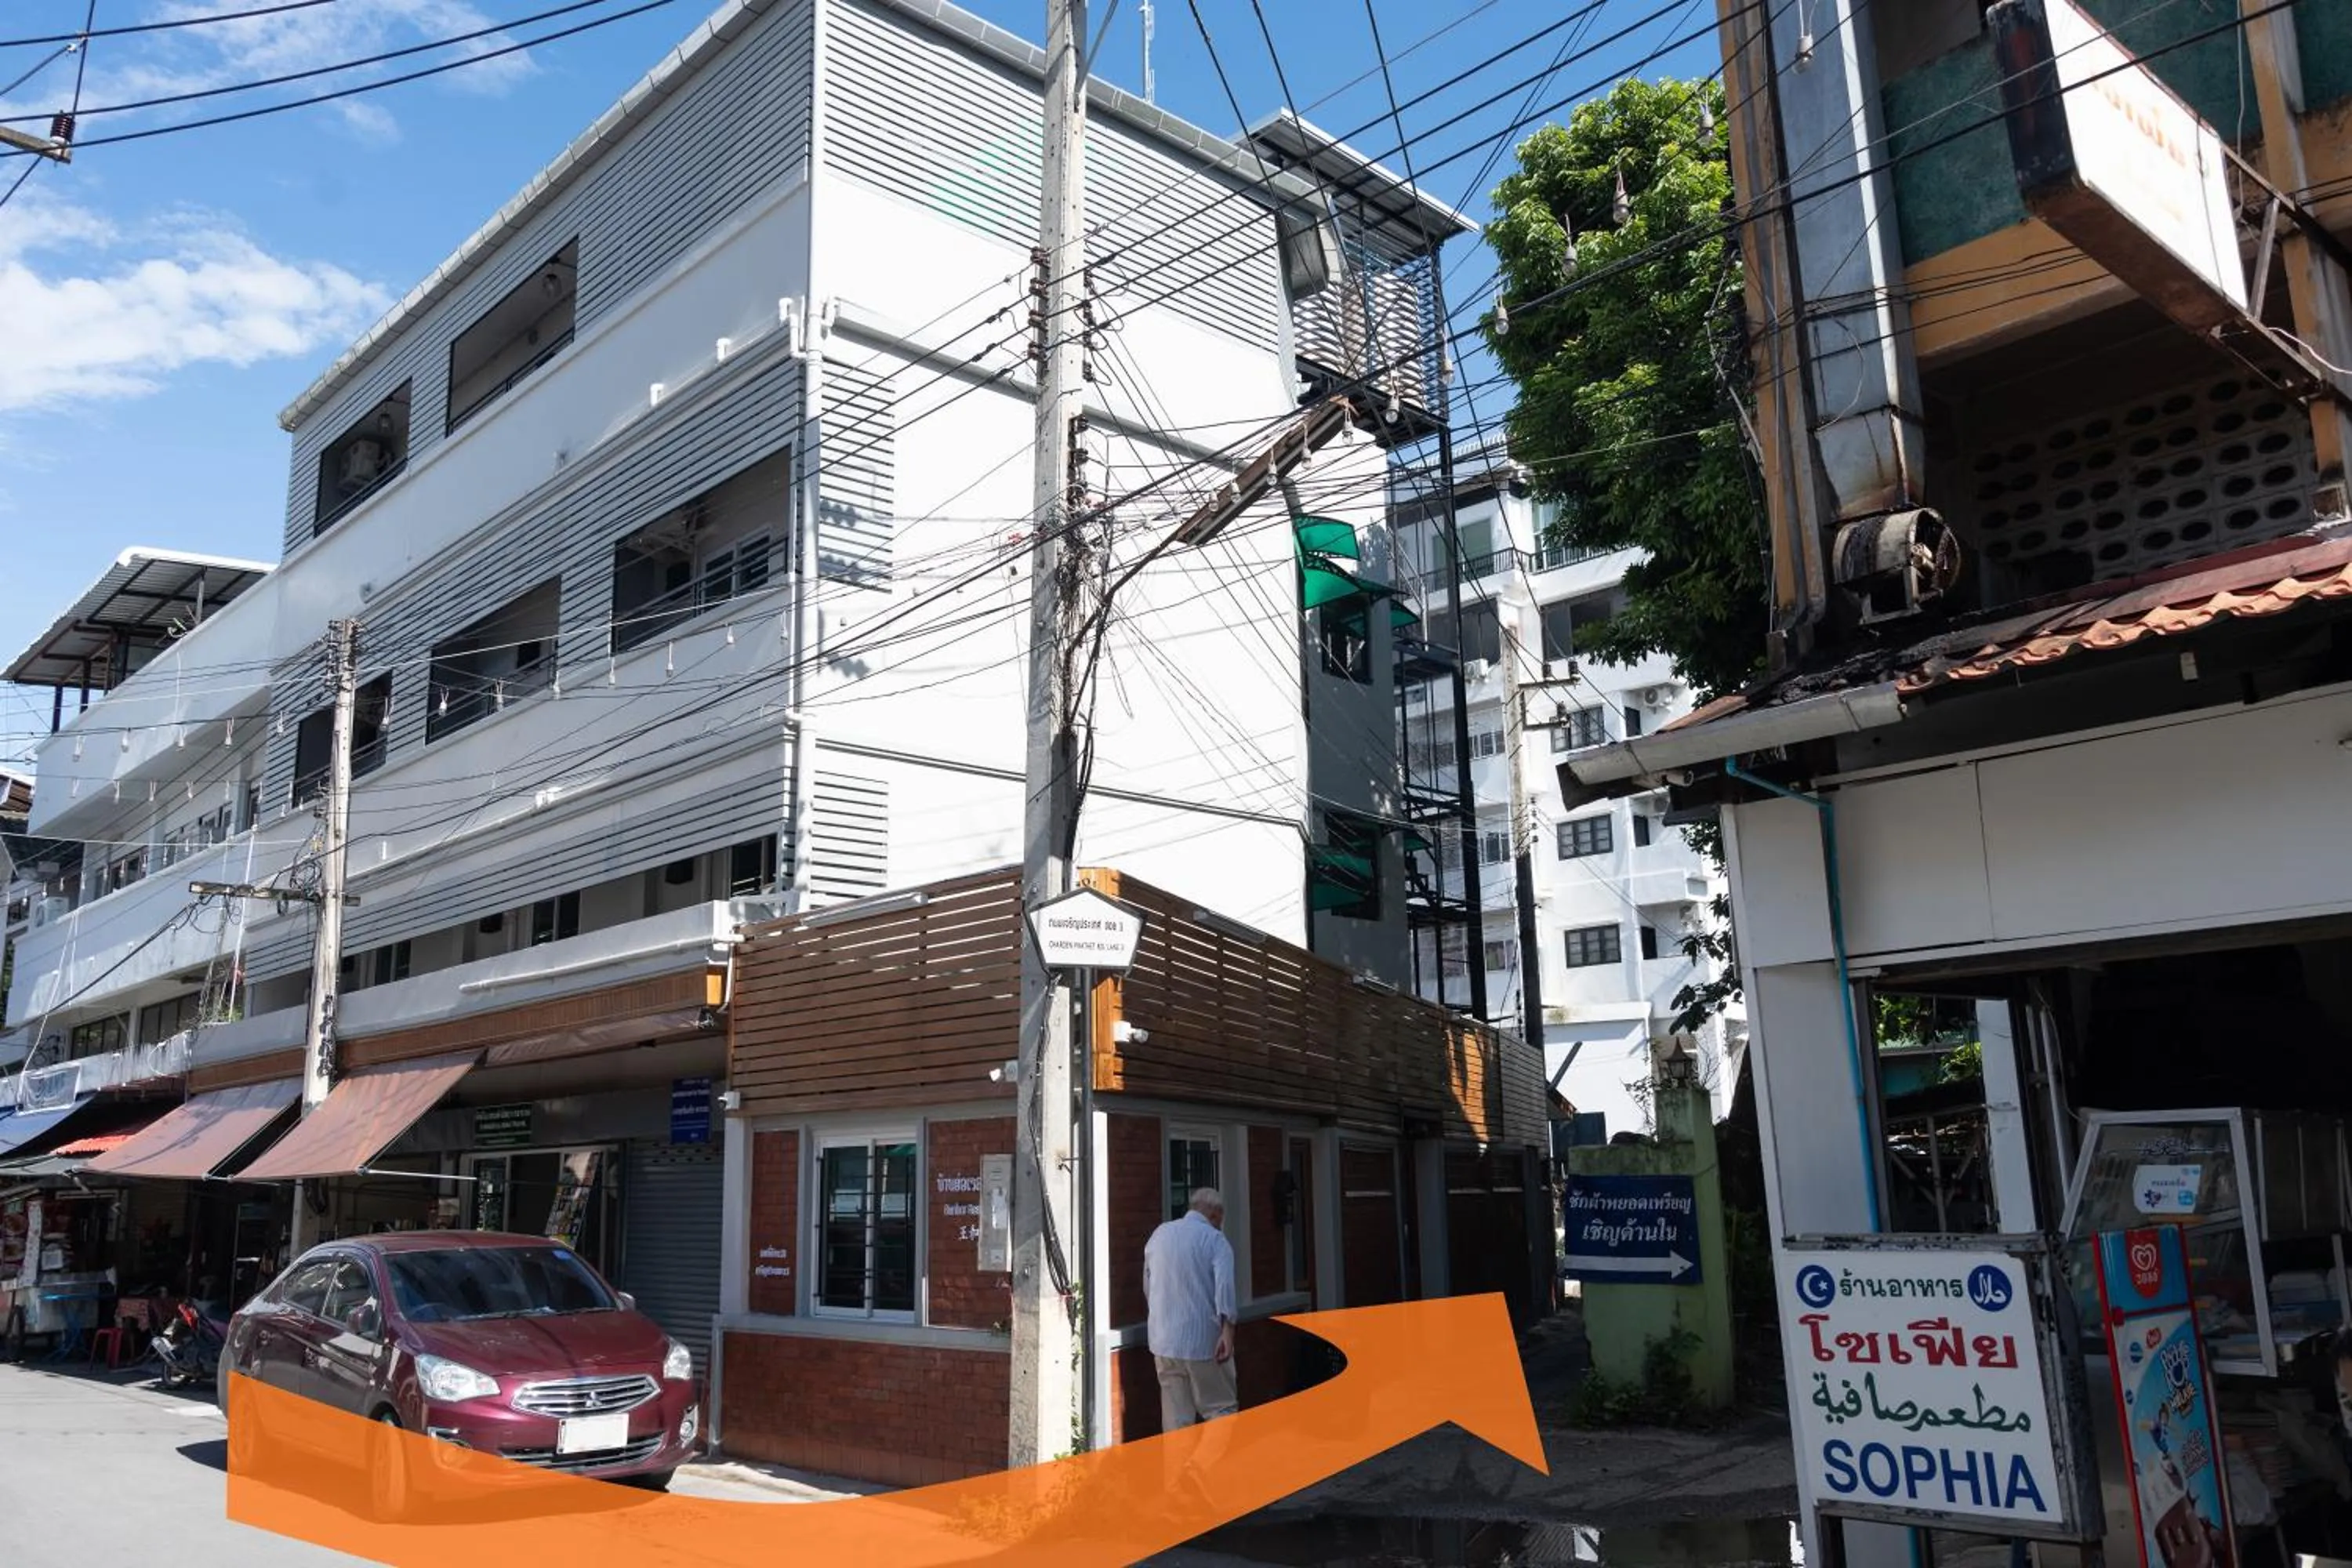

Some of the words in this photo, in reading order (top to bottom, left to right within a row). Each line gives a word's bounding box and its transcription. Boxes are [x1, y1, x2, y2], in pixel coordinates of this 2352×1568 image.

[1569, 1189, 1692, 1214] ซักผ้าหยอดเหรียญ
[1582, 1217, 1678, 1247] เชิญด้านใน
[1839, 1268, 1964, 1298] ร้านอาหาร
[1798, 1313, 2019, 1369] โซเฟีย
[1903, 1382, 2031, 1432] مطعم
[1823, 1439, 2047, 1512] SOPHIA
